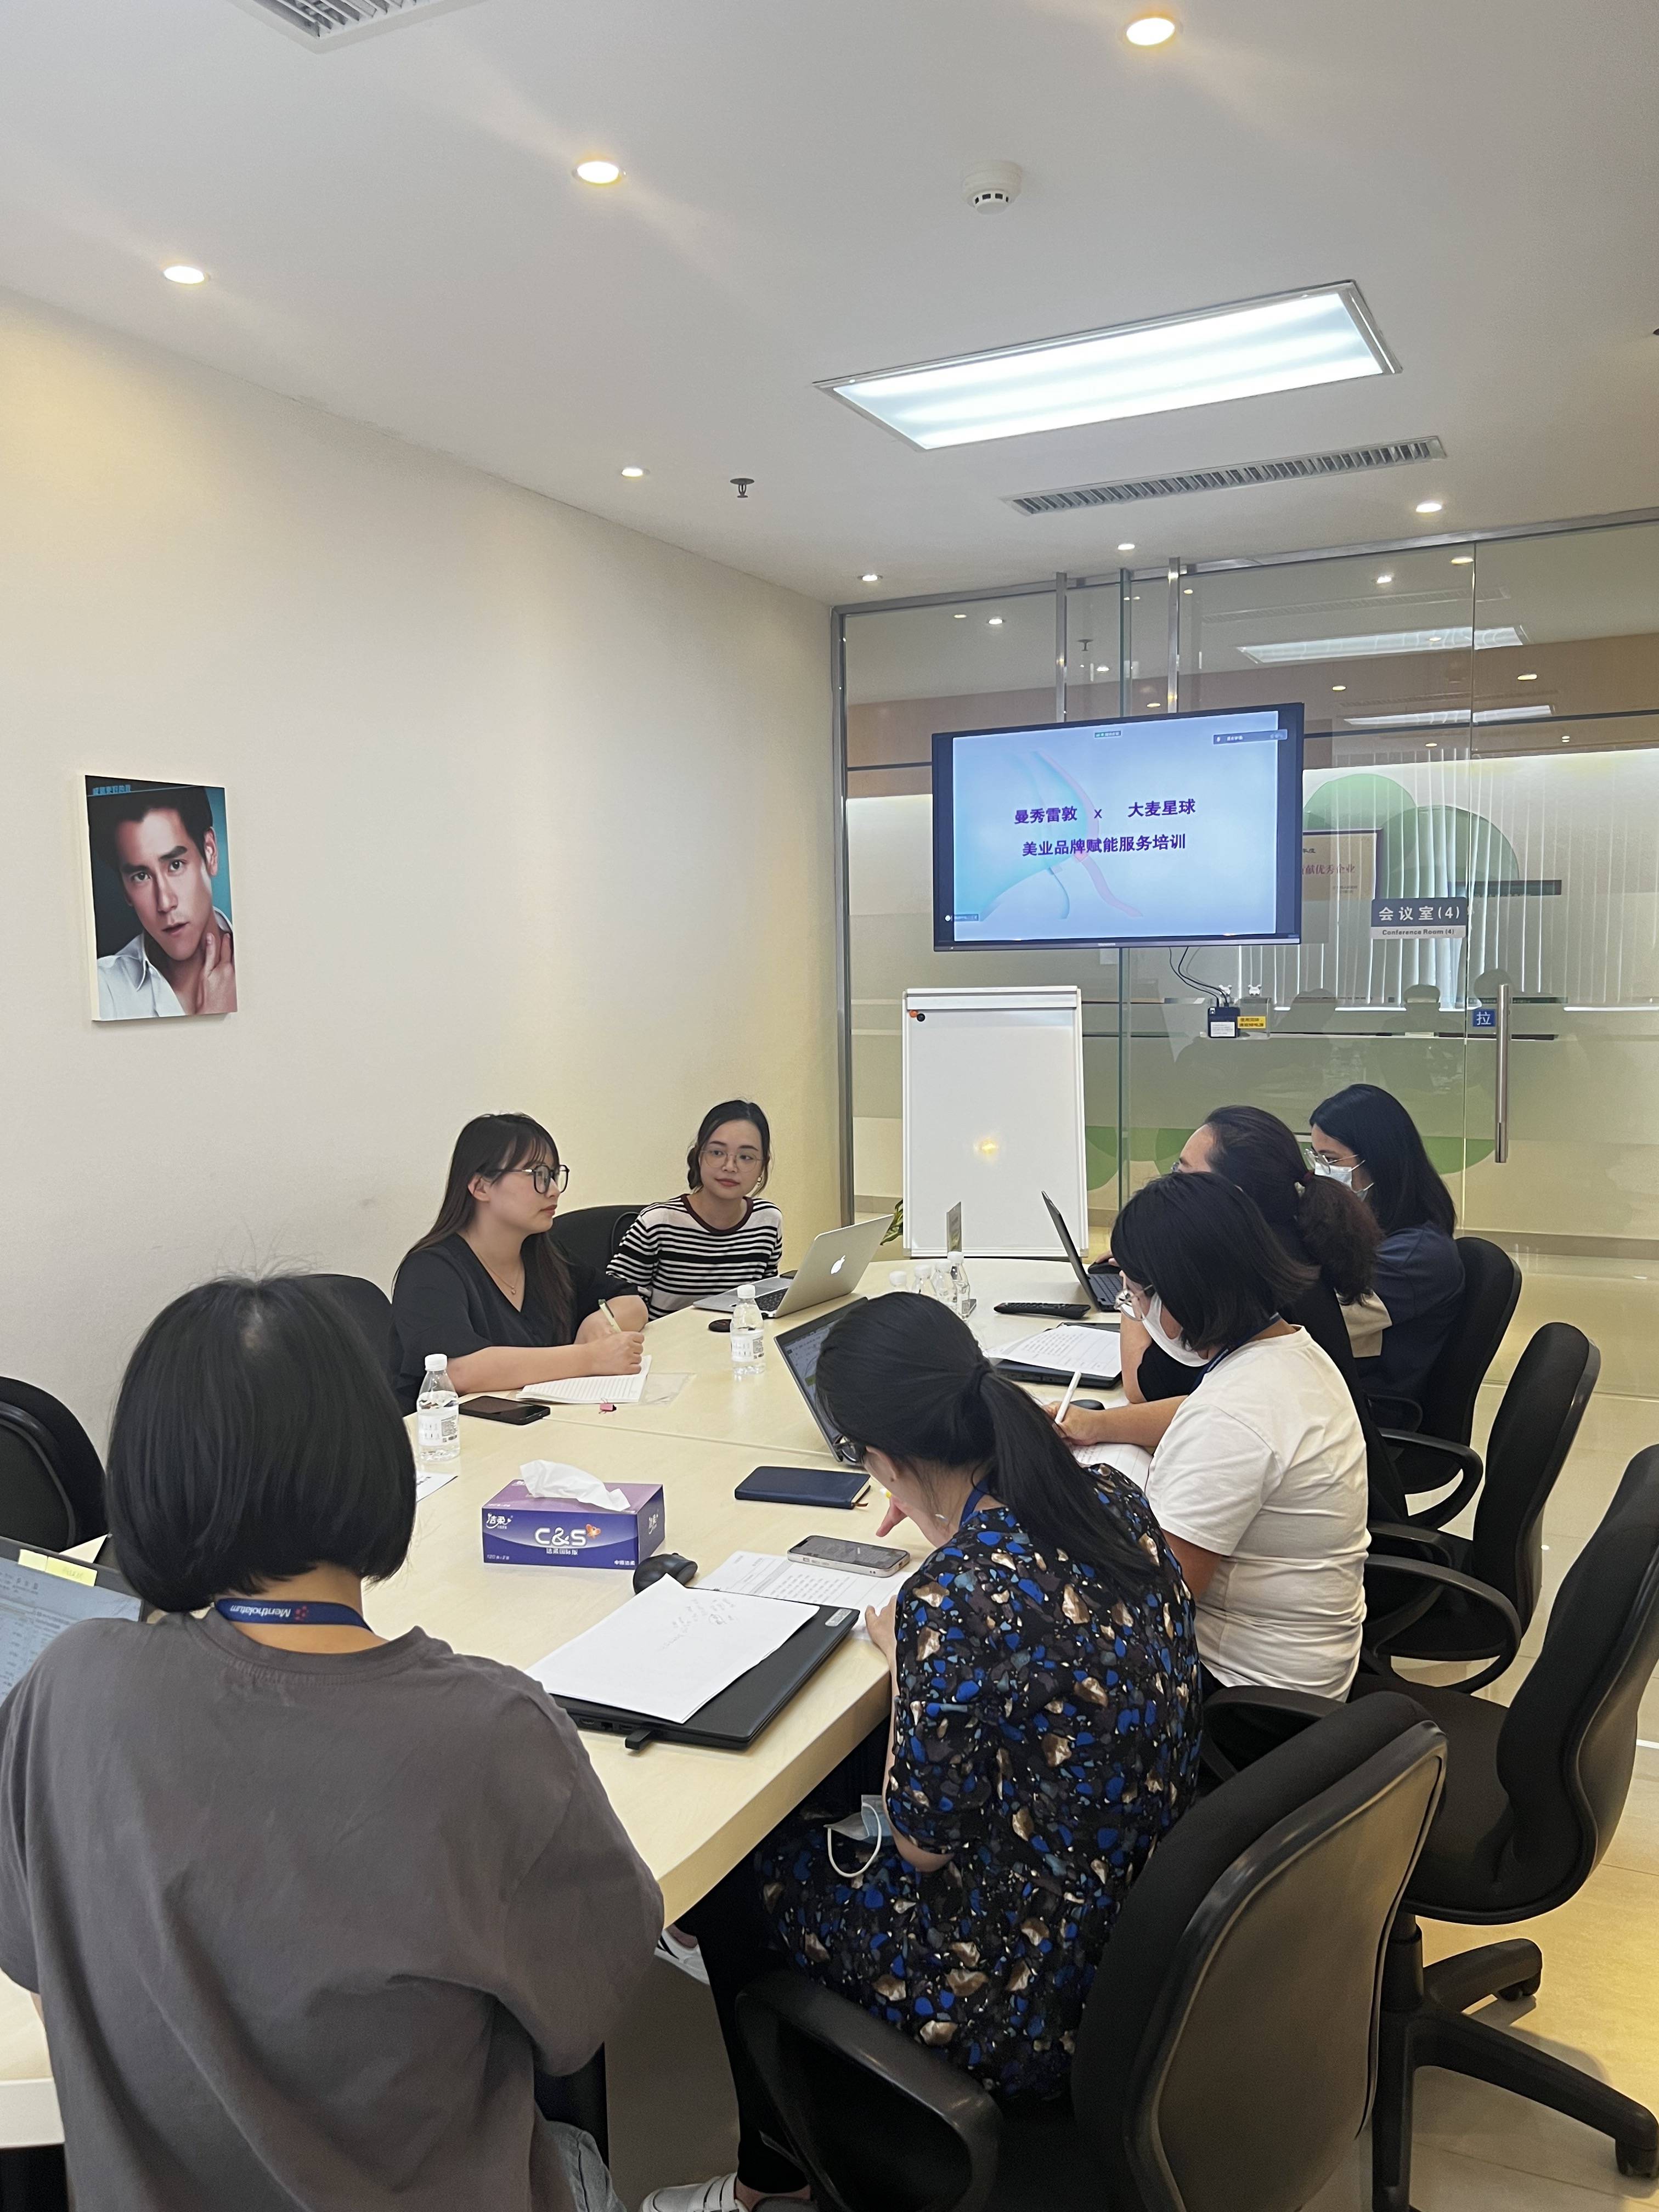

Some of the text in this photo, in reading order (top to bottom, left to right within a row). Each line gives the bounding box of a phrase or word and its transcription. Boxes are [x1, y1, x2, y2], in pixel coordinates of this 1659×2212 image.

[1014, 805, 1077, 824] 曼秀雷敦
[1127, 798, 1196, 817] 大麦星球
[1022, 833, 1186, 856] 美业品牌赋能服务培训
[1302, 863, 1356, 875] 献优秀企业
[1476, 1011, 1491, 1025] 拉
[535, 1527, 586, 1547] C&S
[230, 1605, 291, 1618] Mentholatum
